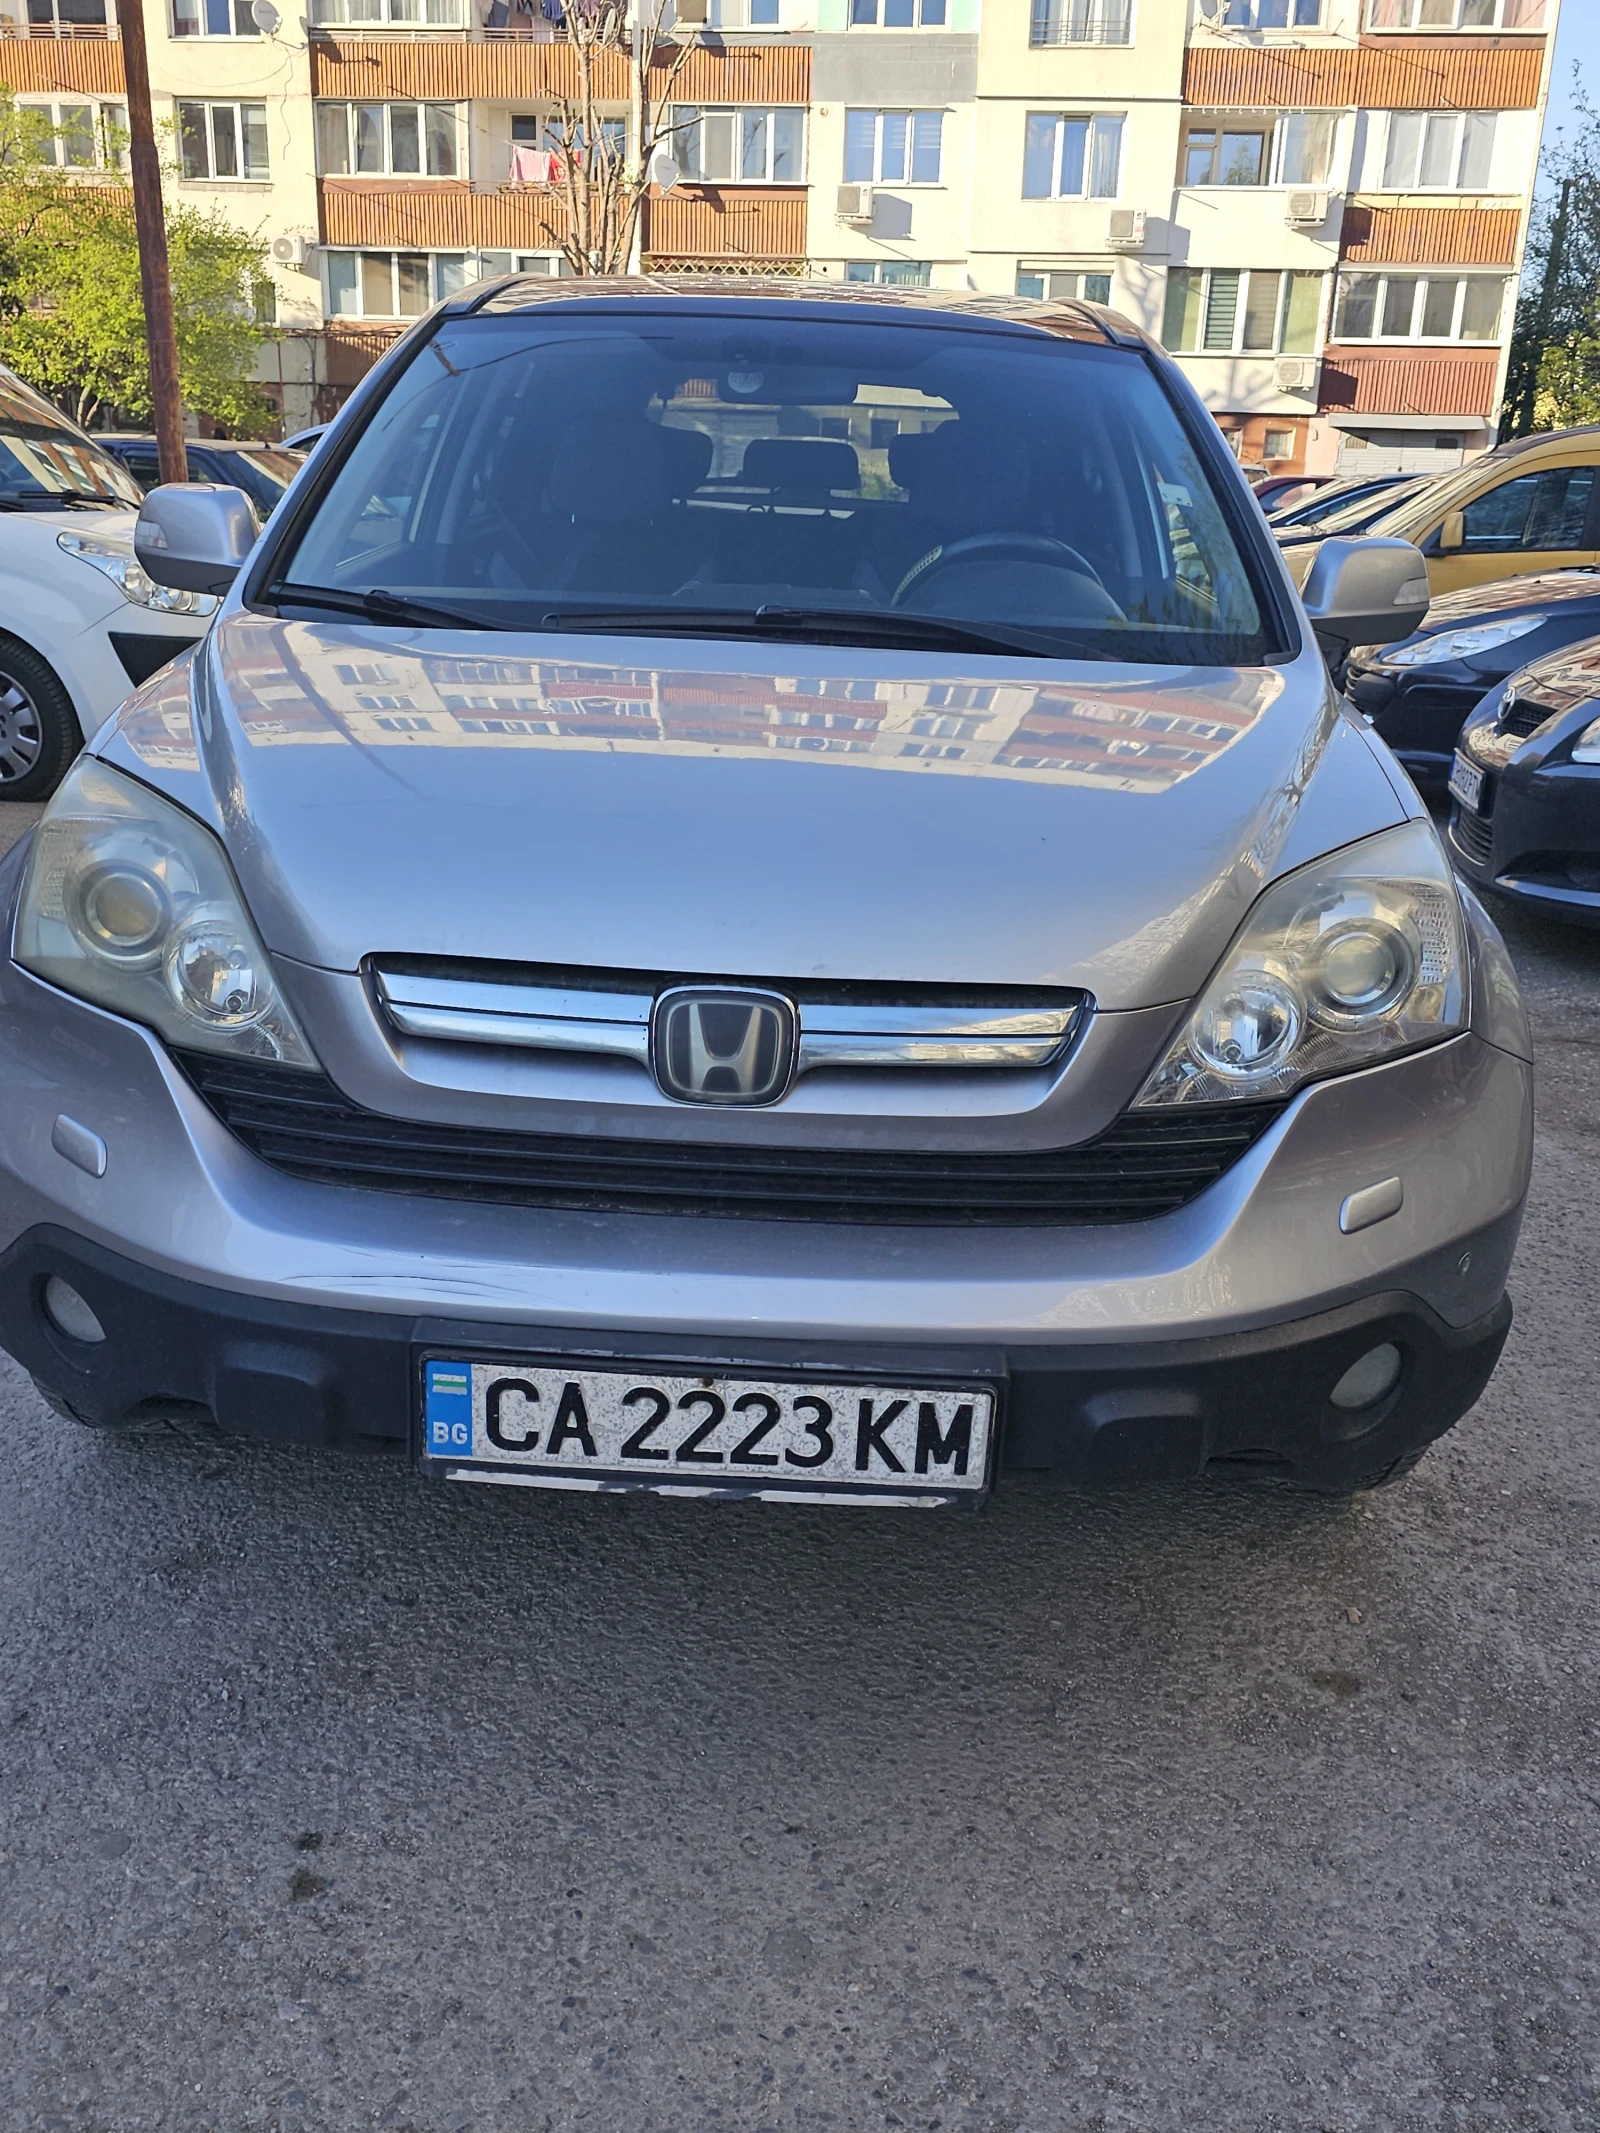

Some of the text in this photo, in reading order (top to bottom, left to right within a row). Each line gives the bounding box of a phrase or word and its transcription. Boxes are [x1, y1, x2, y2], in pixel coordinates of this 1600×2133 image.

[433, 1421, 468, 1445] BG
[485, 1377, 974, 1476] CA 2223 KM
